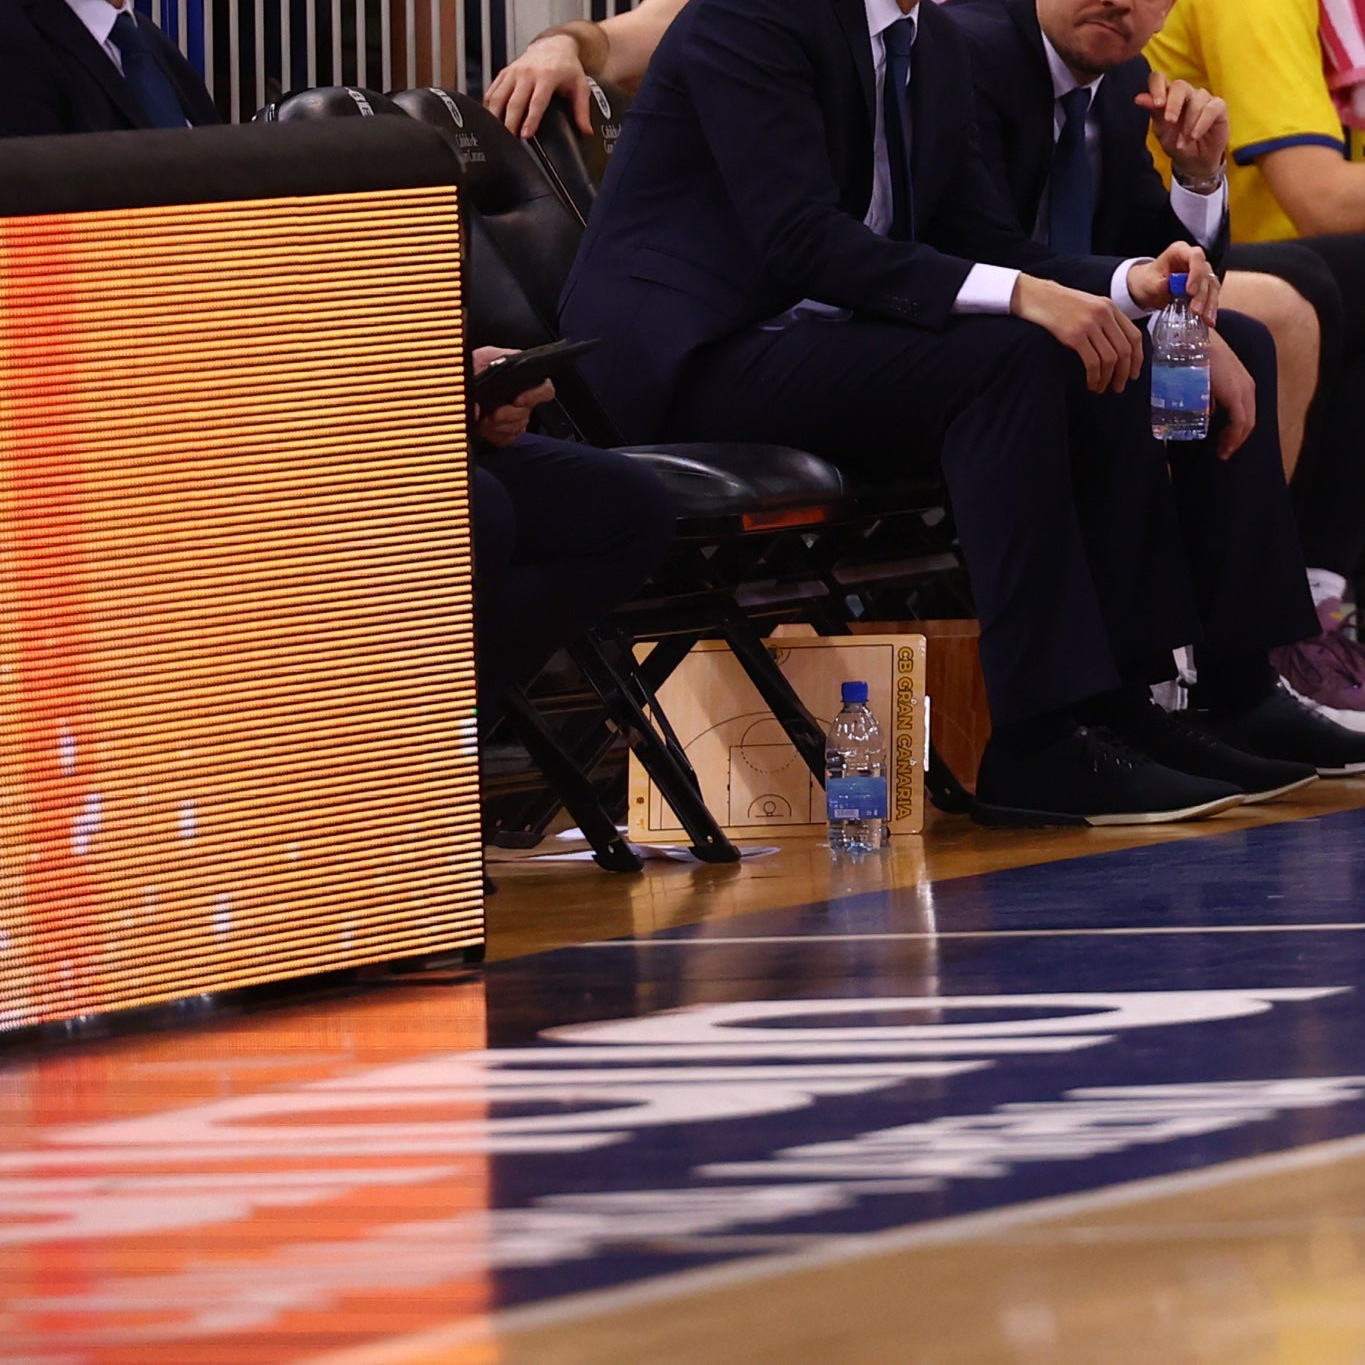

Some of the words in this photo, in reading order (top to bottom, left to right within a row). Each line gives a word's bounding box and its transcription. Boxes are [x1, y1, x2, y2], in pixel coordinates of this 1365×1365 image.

[898, 646, 914, 673] CB
[896, 676, 914, 730] GRAN
[895, 733, 913, 821] CANARIA
